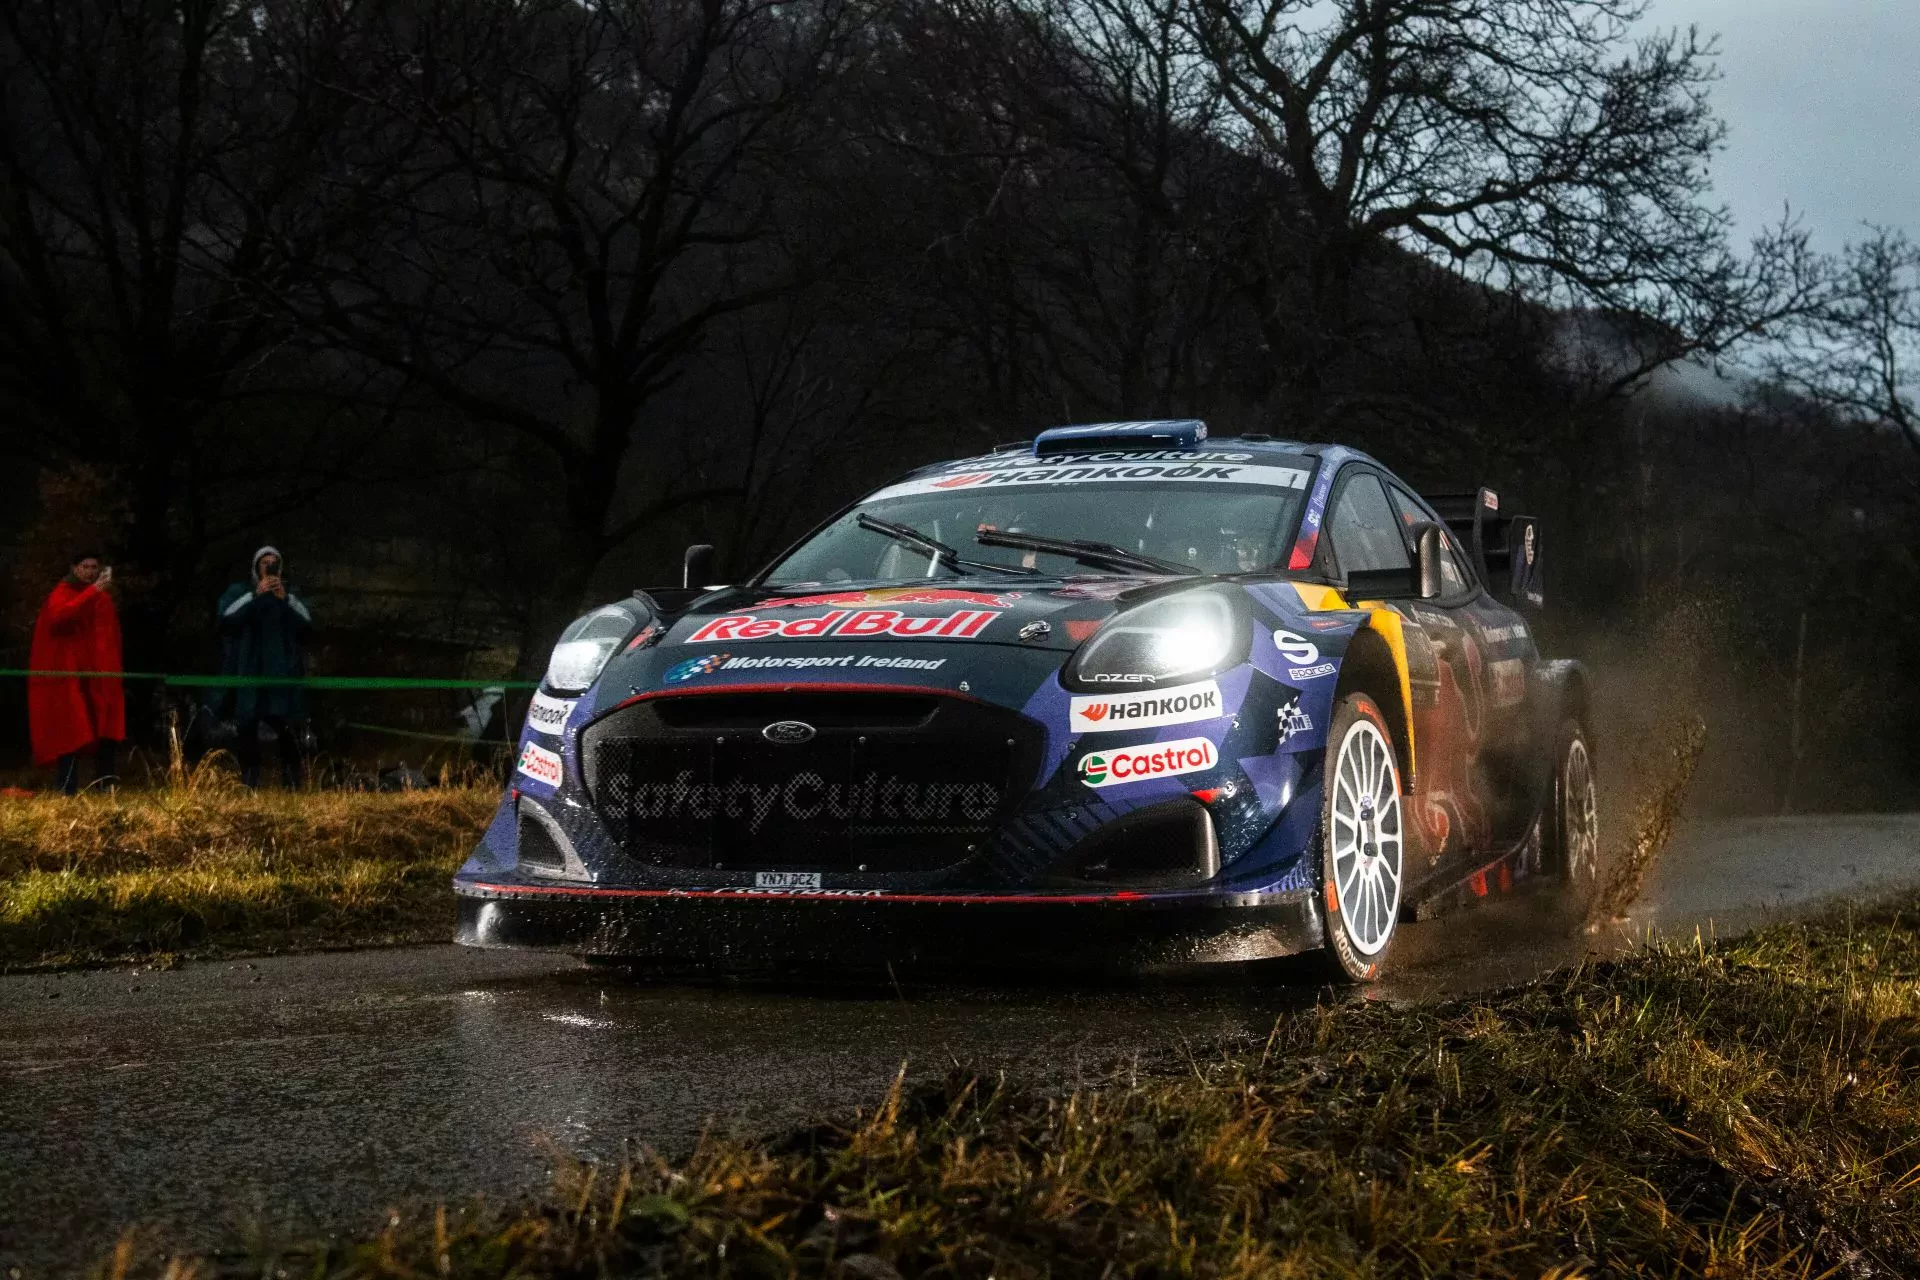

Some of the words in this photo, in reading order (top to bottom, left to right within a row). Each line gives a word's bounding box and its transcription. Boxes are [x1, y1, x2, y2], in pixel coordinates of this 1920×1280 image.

[684, 610, 853, 643] Red
[831, 610, 1003, 639] Bull
[720, 655, 855, 670] Motorsport
[854, 655, 947, 671] Ireland
[1291, 664, 1333, 677] sparco
[526, 749, 560, 780] Castrol
[1111, 743, 1211, 778] Castrol
[604, 770, 1000, 835] SafetyCulture
